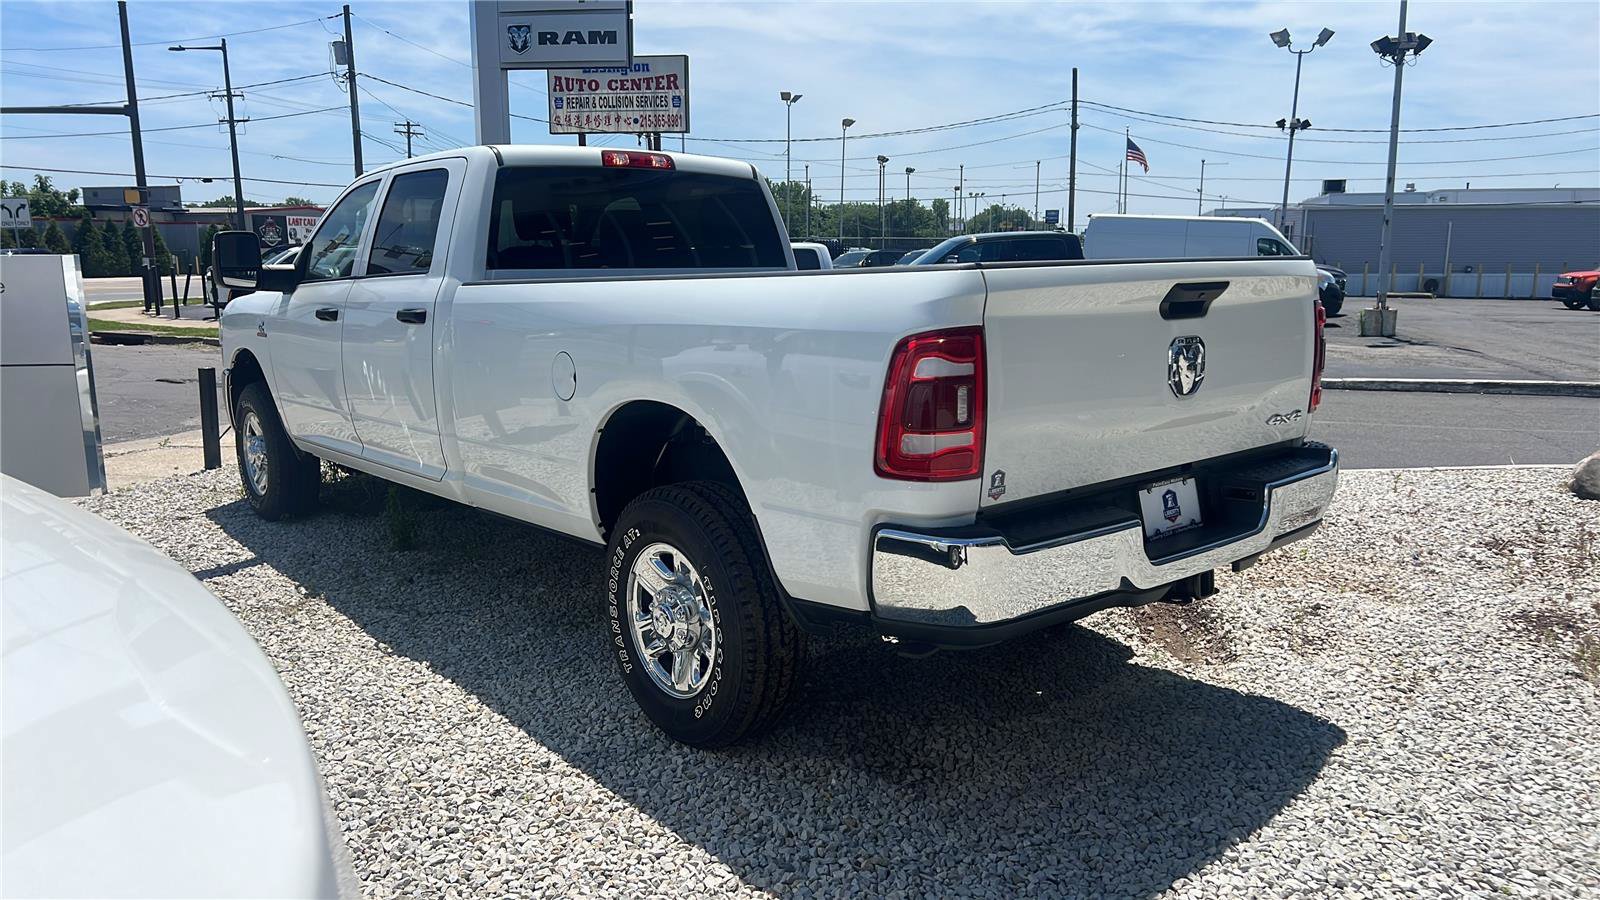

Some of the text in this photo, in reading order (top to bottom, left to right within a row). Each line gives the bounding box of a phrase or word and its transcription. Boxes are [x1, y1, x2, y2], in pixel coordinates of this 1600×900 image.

[538, 30, 617, 45] RAM
[553, 73, 679, 92] AUTO CENTER
[566, 96, 590, 110] REPAIR
[592, 98, 597, 109] &
[598, 96, 634, 109] COLLISION
[635, 95, 669, 108] SERVICES
[288, 217, 302, 226] LAST
[608, 547, 634, 674] TRANSFORCE
